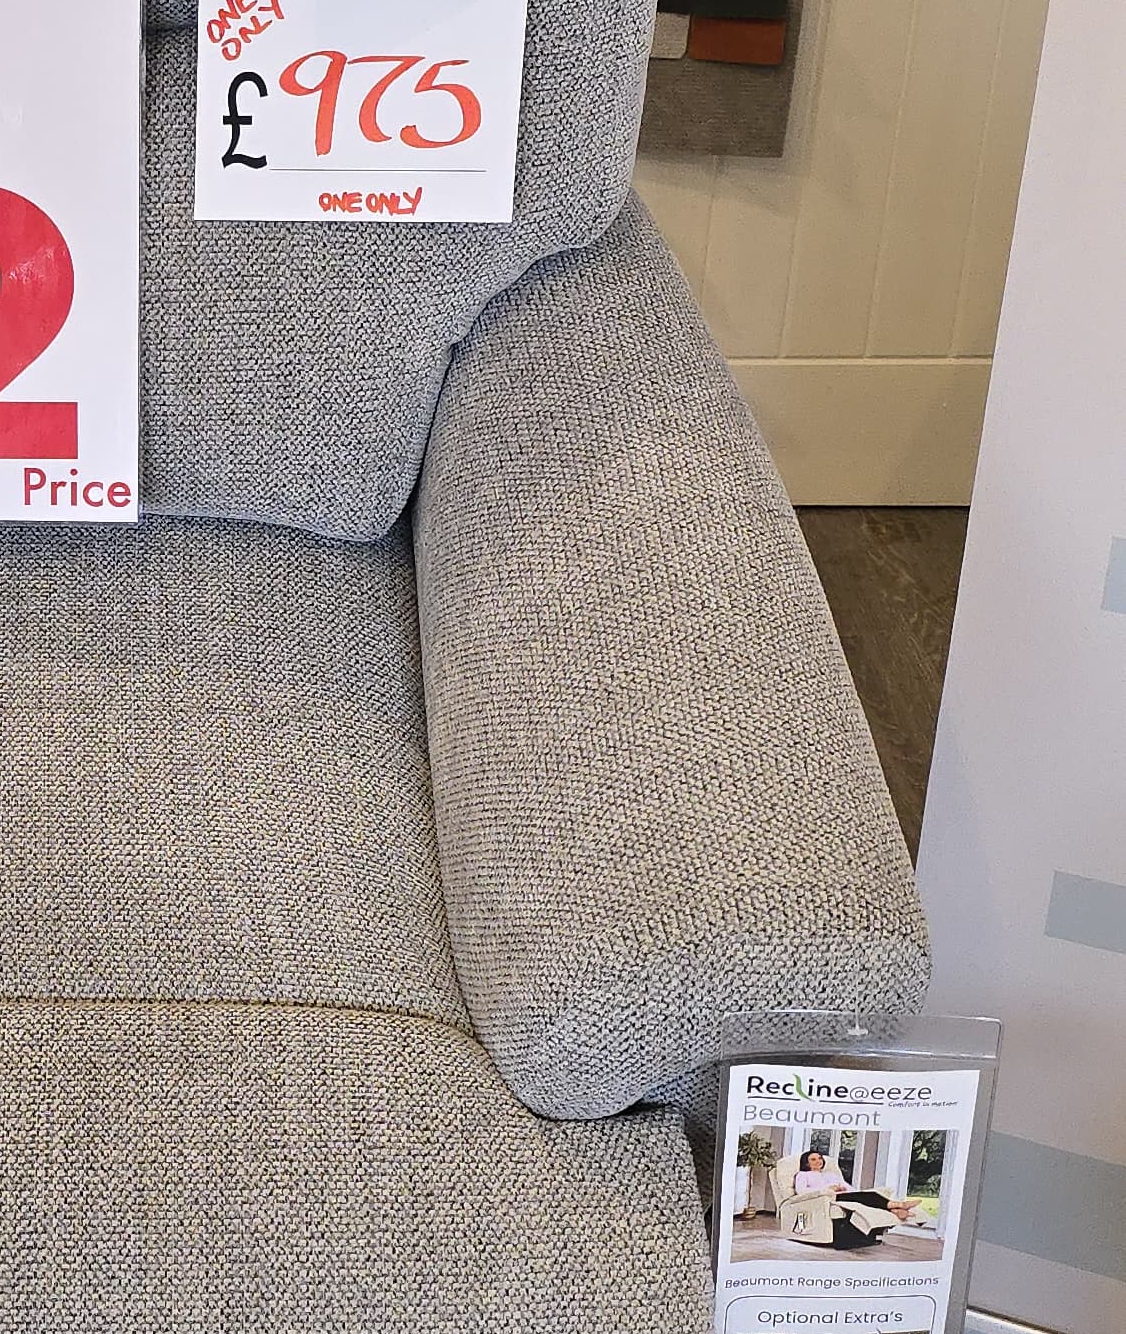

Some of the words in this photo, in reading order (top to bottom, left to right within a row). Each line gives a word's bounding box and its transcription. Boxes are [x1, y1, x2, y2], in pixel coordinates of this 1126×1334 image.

[318, 191, 363, 213] ONE
[365, 187, 422, 215] ONLY
[24, 467, 132, 509] Price
[743, 1104, 881, 1126] Beaumont
[725, 1277, 794, 1289] Beaumont
[797, 1276, 841, 1289] Range
[844, 1275, 939, 1290] Specifications
[757, 1310, 838, 1327] Optional
[844, 1310, 903, 1324] Extra's
